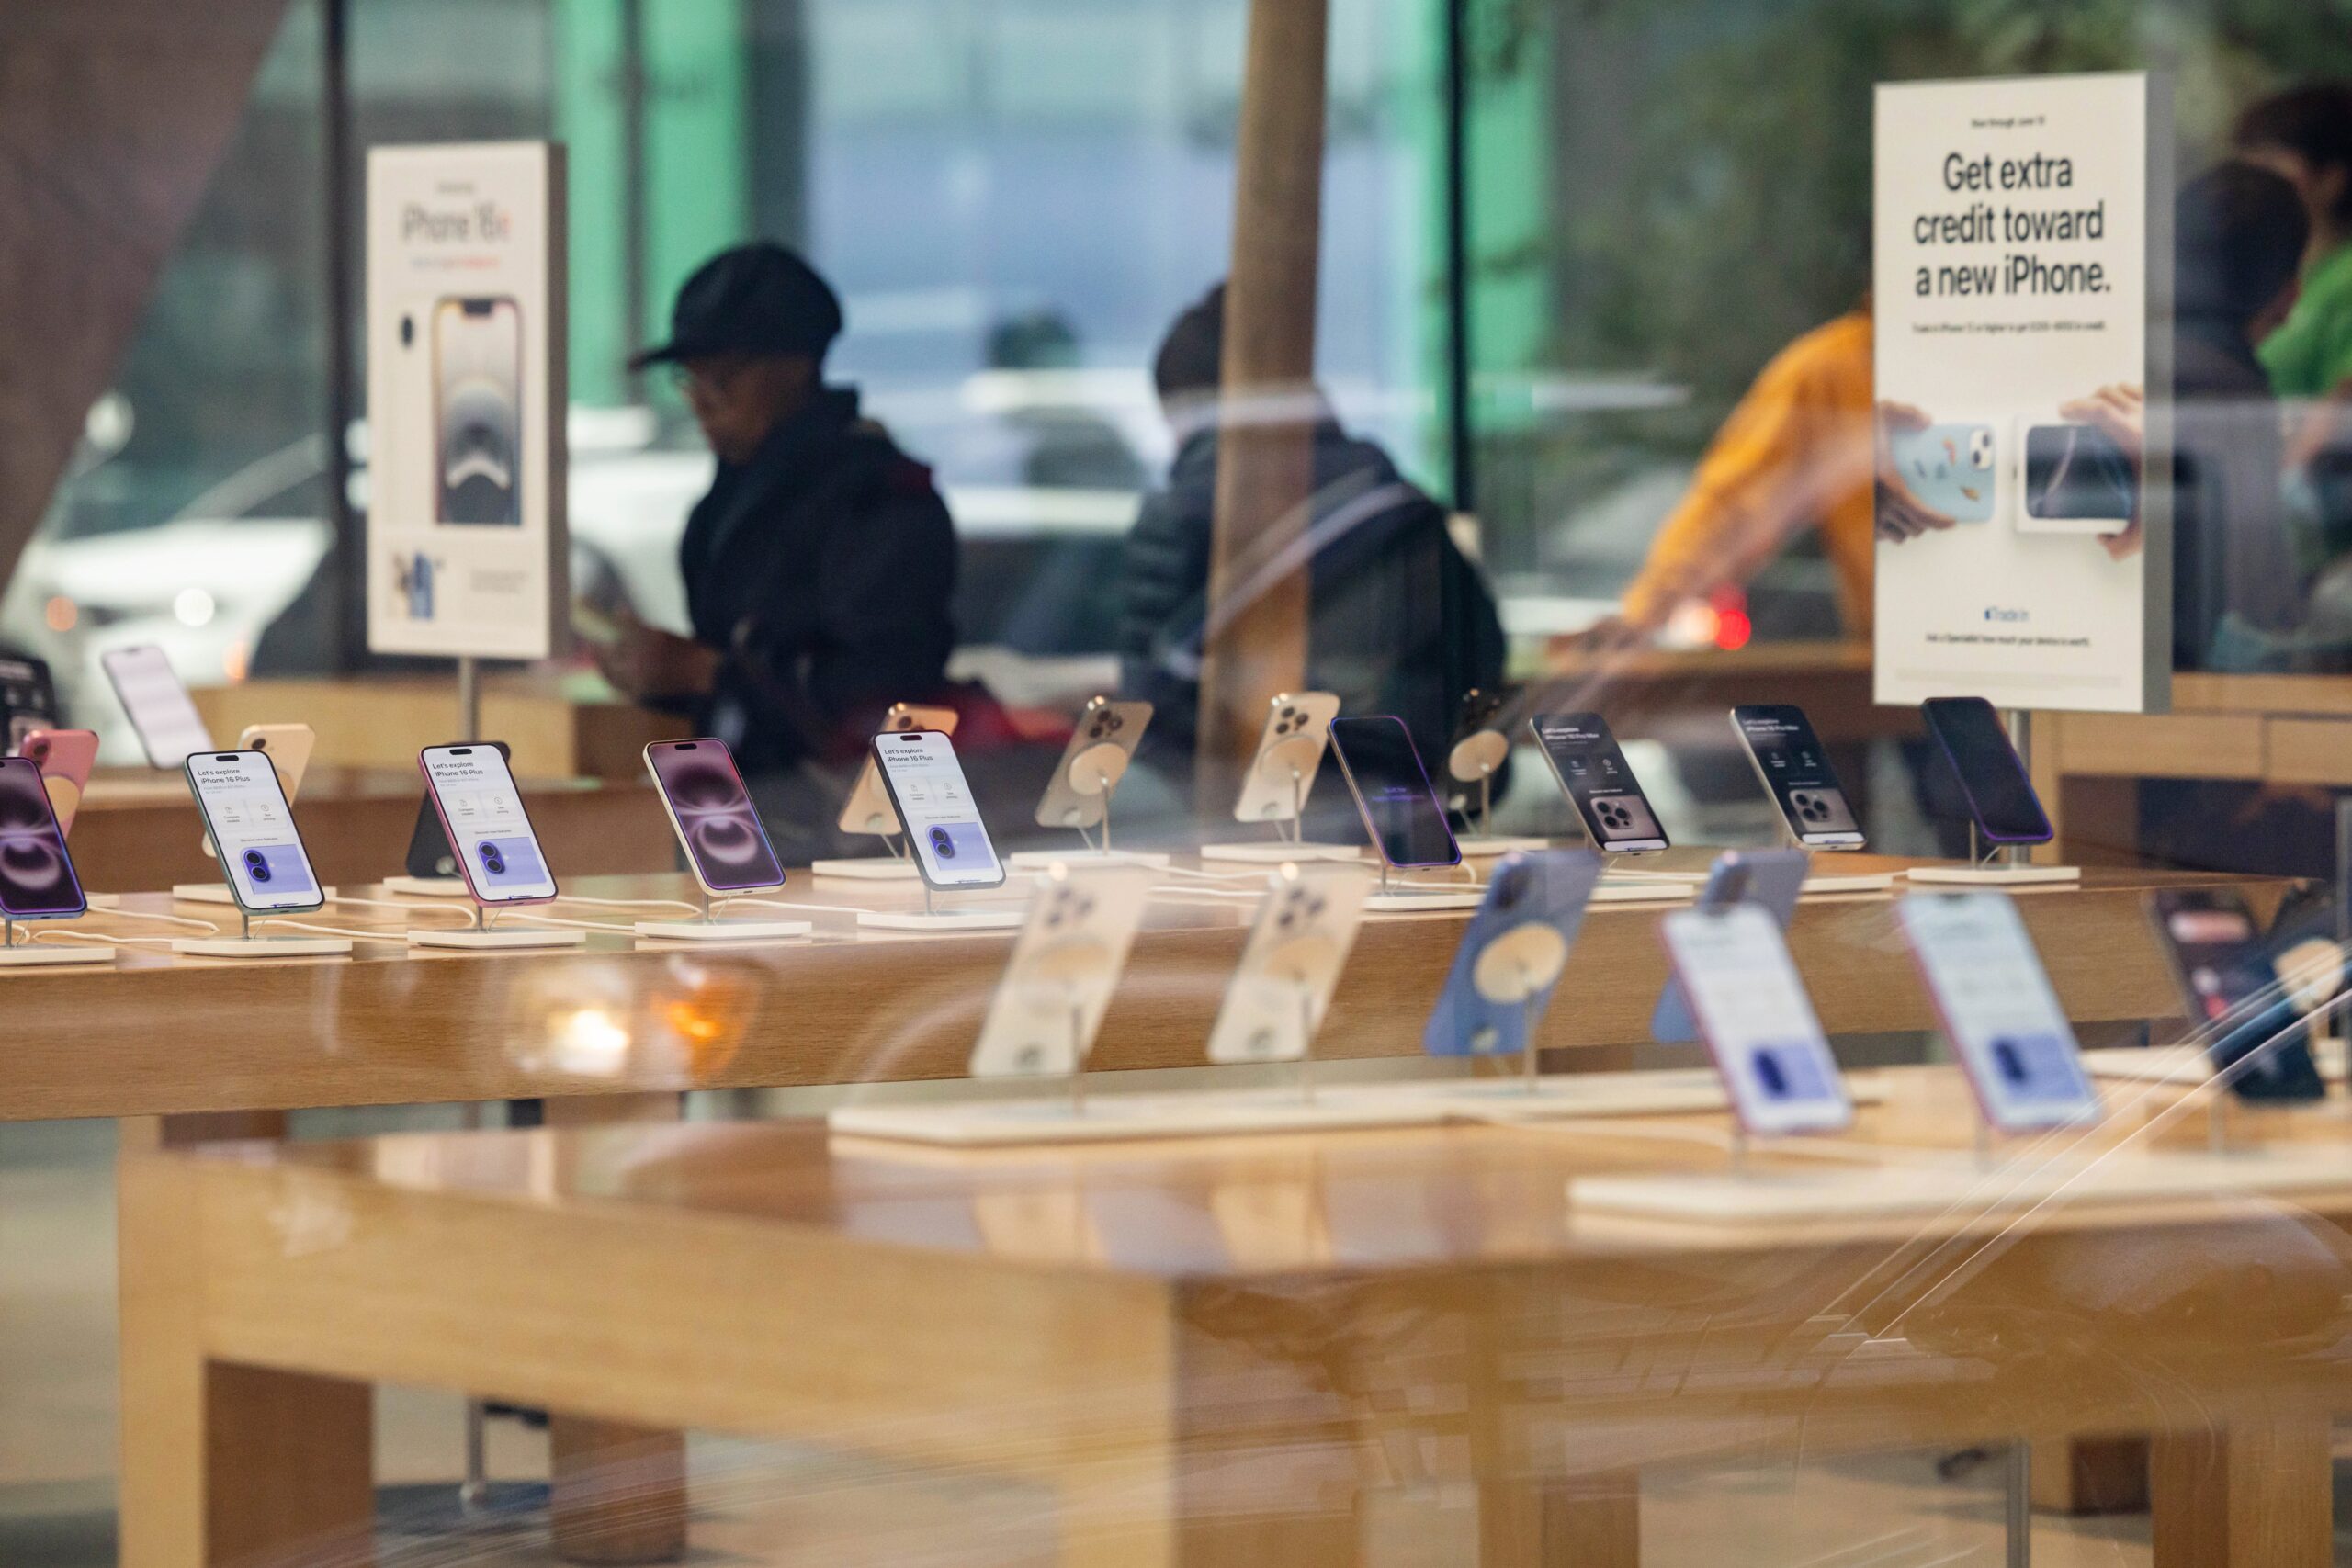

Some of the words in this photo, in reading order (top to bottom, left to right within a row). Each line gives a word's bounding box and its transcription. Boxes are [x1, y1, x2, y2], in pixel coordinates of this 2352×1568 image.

[1943, 152, 1993, 191] Get
[2000, 152, 2073, 190] extra
[1914, 202, 1995, 244] credit
[2004, 199, 2104, 242] toward
[1916, 266, 1930, 296] a
[1939, 264, 1997, 296] new
[2005, 254, 2111, 293] iPhone.
[215, 768, 241, 776] explore
[449, 761, 474, 770] explore
